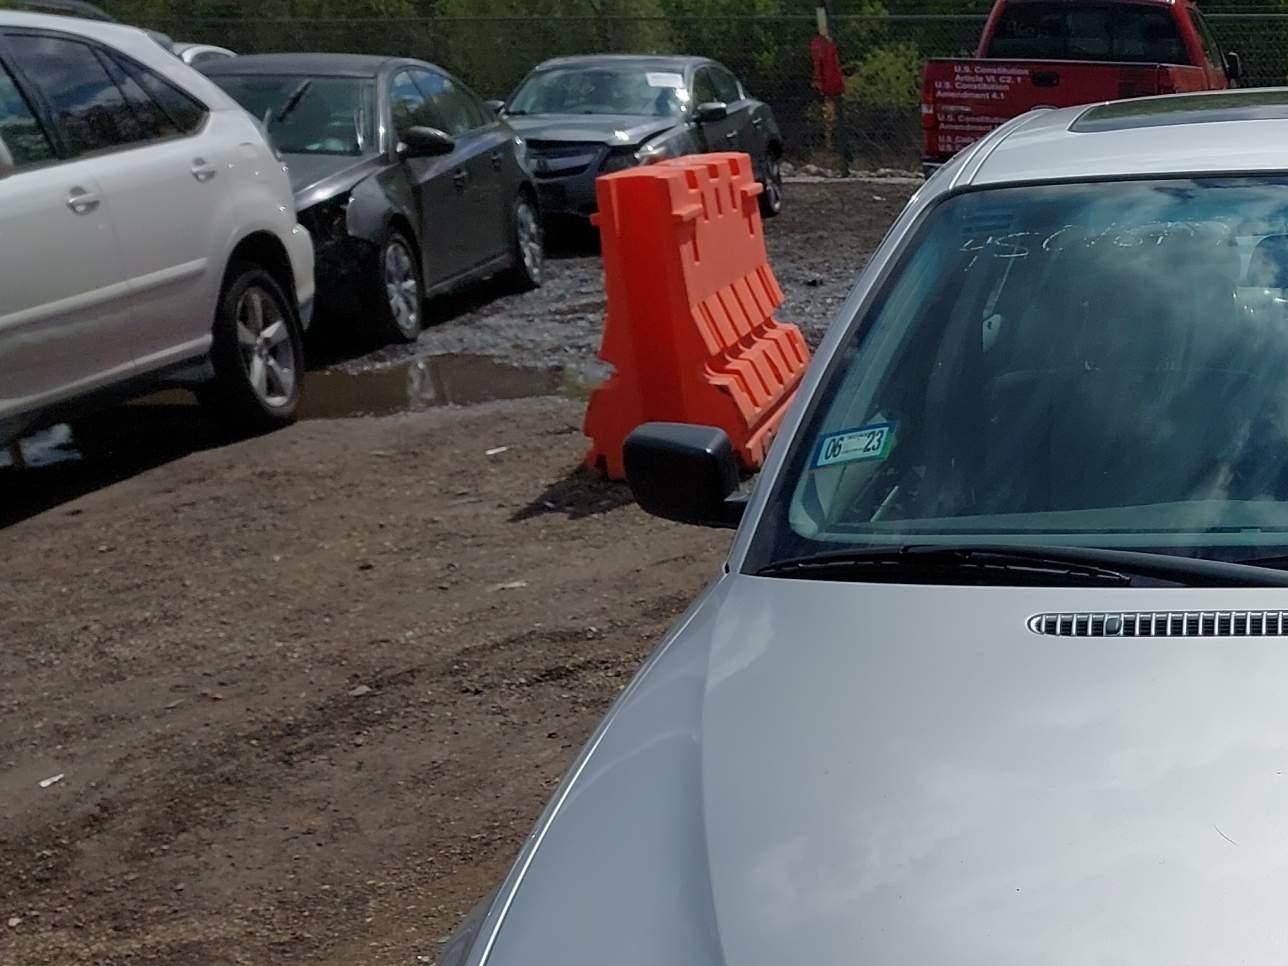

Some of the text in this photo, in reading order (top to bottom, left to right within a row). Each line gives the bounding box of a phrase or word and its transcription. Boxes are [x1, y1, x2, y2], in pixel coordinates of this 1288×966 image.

[974, 66, 1030, 76] Constitution
[954, 82, 1010, 91] Constitution
[935, 90, 989, 100] Amendment
[957, 115, 1009, 123] Constitutio
[824, 430, 885, 461] 06 23
